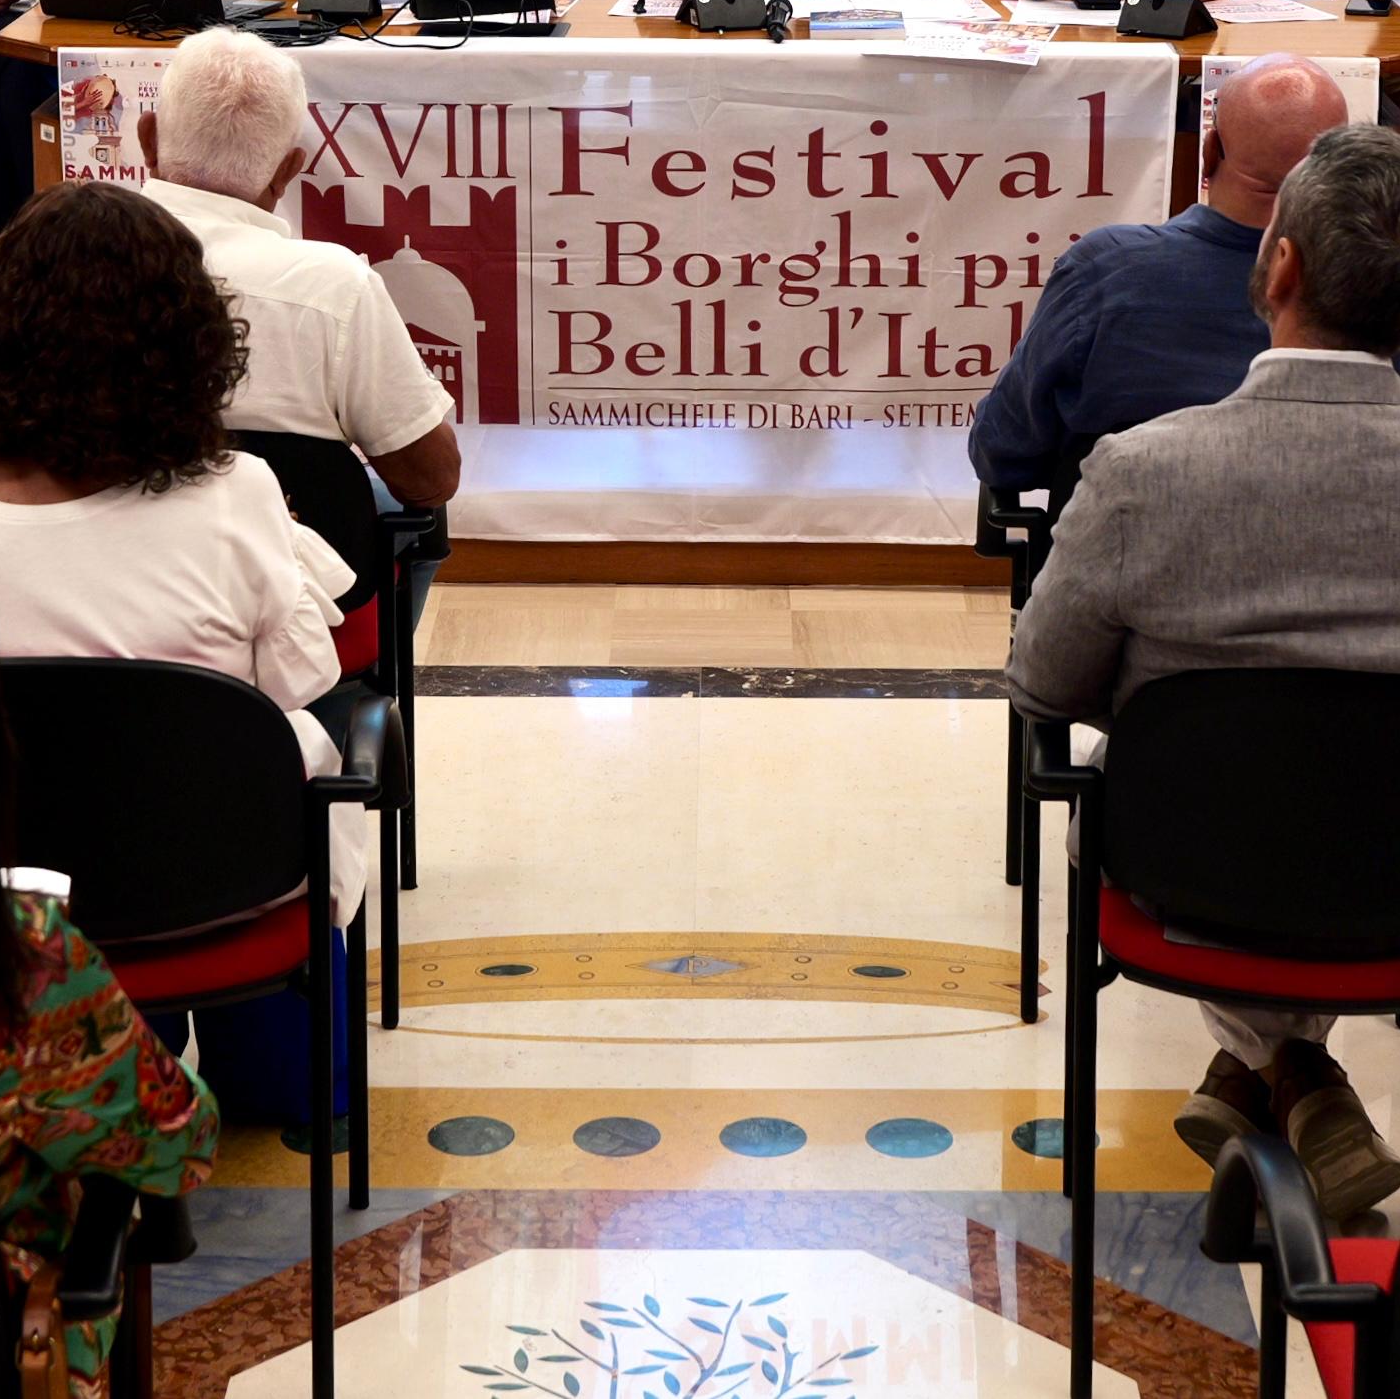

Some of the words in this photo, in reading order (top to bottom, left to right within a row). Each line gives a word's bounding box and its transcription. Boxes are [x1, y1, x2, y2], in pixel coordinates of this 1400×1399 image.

[63, 80, 76, 162] PUGLIA
[300, 102, 516, 179] XVIII
[548, 91, 1114, 201] Festival
[64, 164, 145, 181] SAMMI
[549, 239, 575, 287] i
[595, 210, 927, 307] Borghi
[955, 231, 1081, 309] pi
[548, 299, 769, 377] Belli
[799, 301, 1023, 378] d’Ital
[548, 401, 736, 429] SAMMICHELE
[747, 403, 786, 429] DI
[789, 403, 853, 430] BARI
